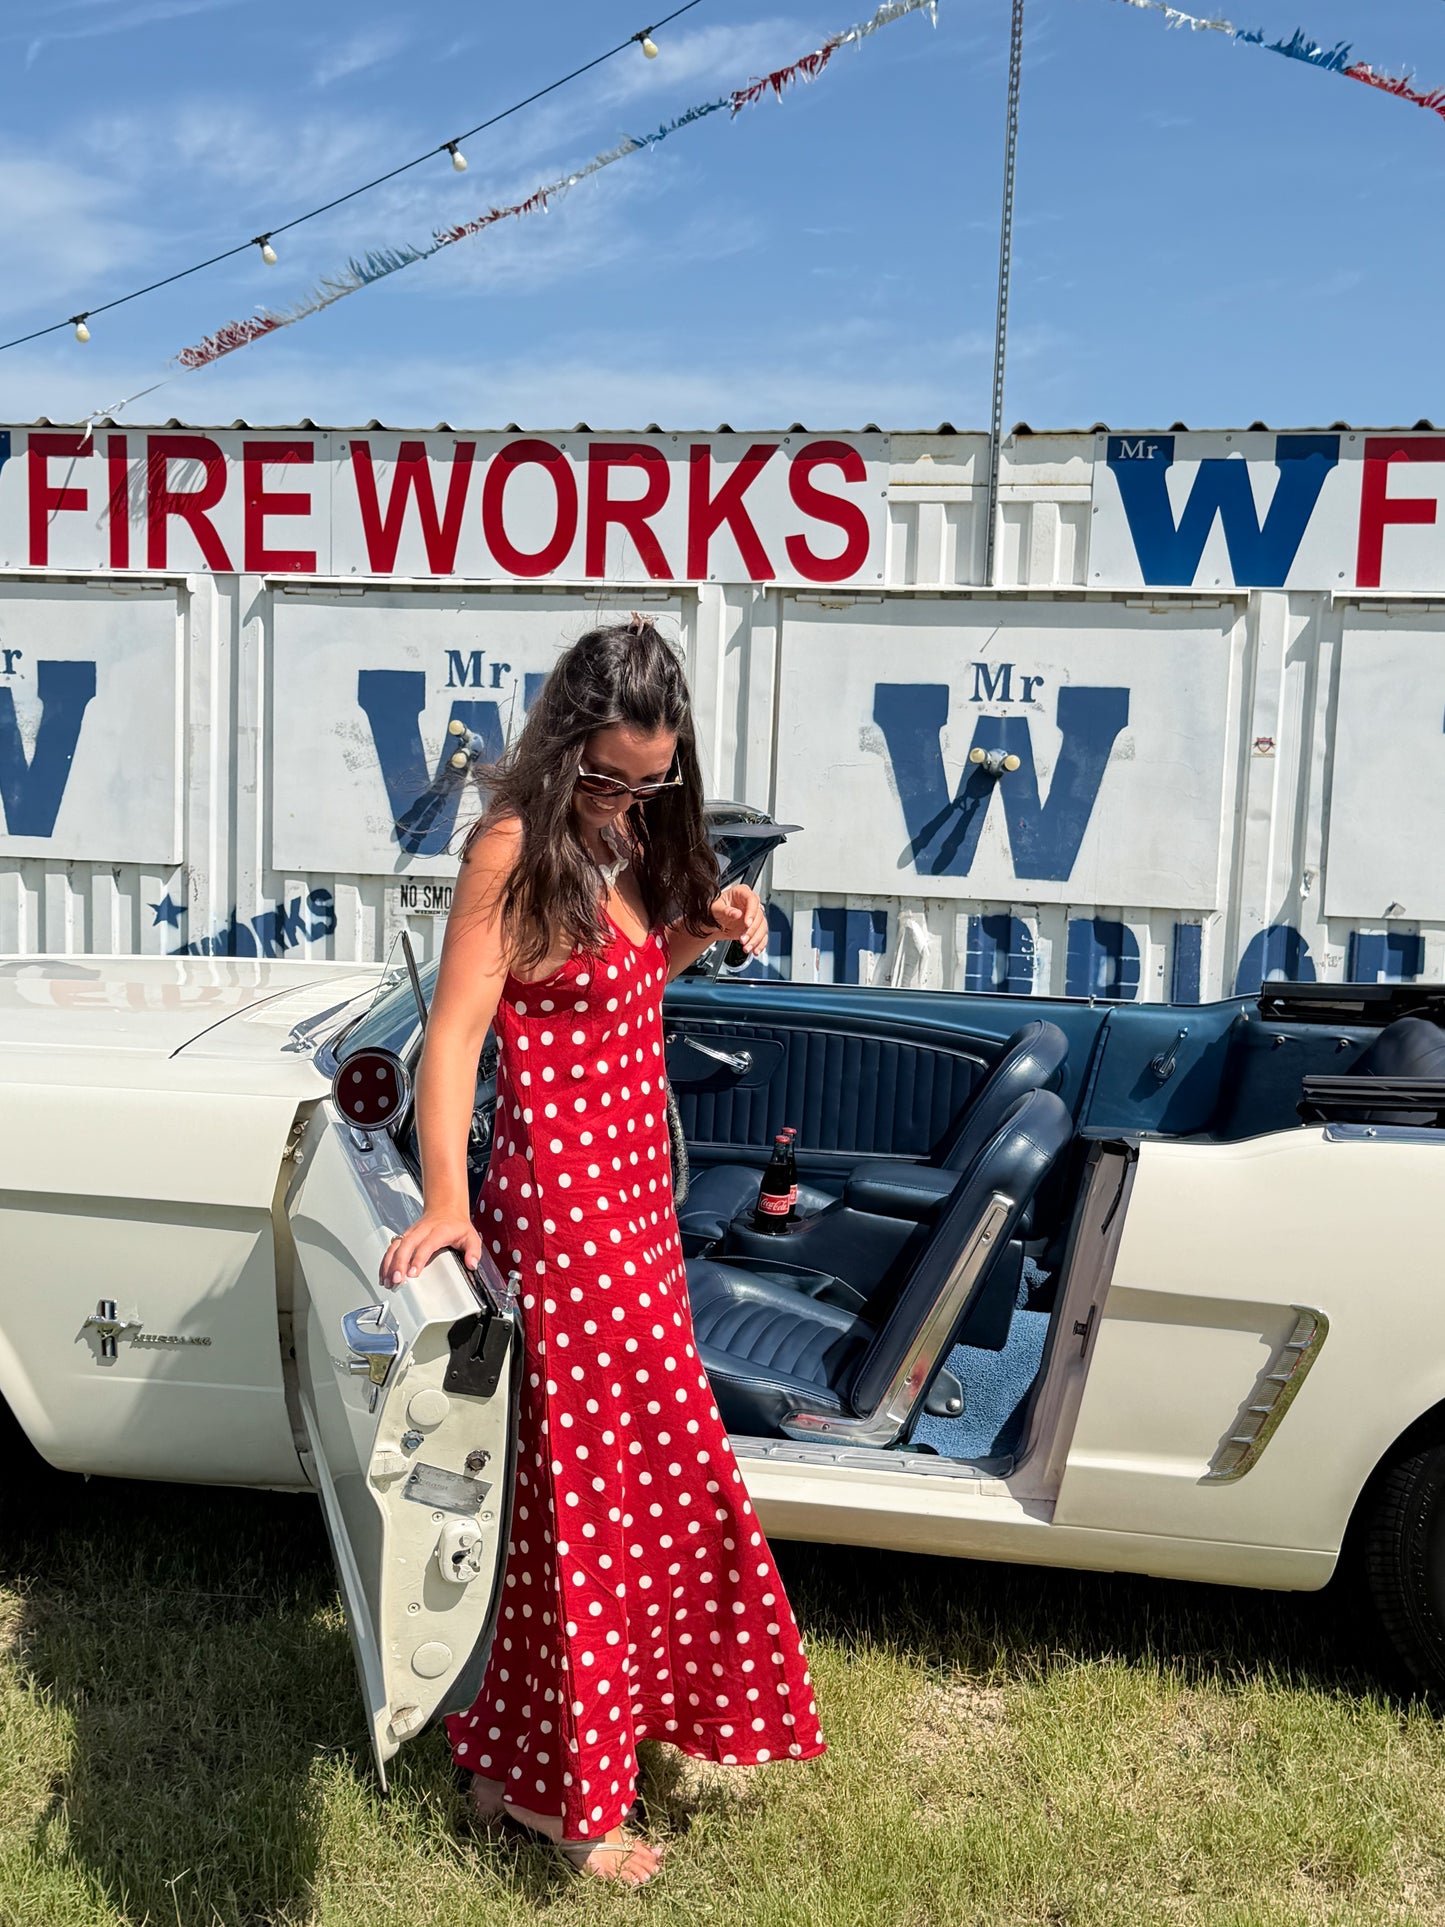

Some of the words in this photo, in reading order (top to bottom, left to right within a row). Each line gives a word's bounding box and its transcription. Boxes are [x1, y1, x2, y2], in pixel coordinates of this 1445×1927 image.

[1118, 439, 1158, 459] Mr
[1106, 436, 1340, 588] W
[0, 650, 22, 674] r
[444, 650, 511, 689] Mr
[969, 662, 1044, 704] Mr
[873, 682, 1130, 882] W
[400, 884, 417, 908] NO
